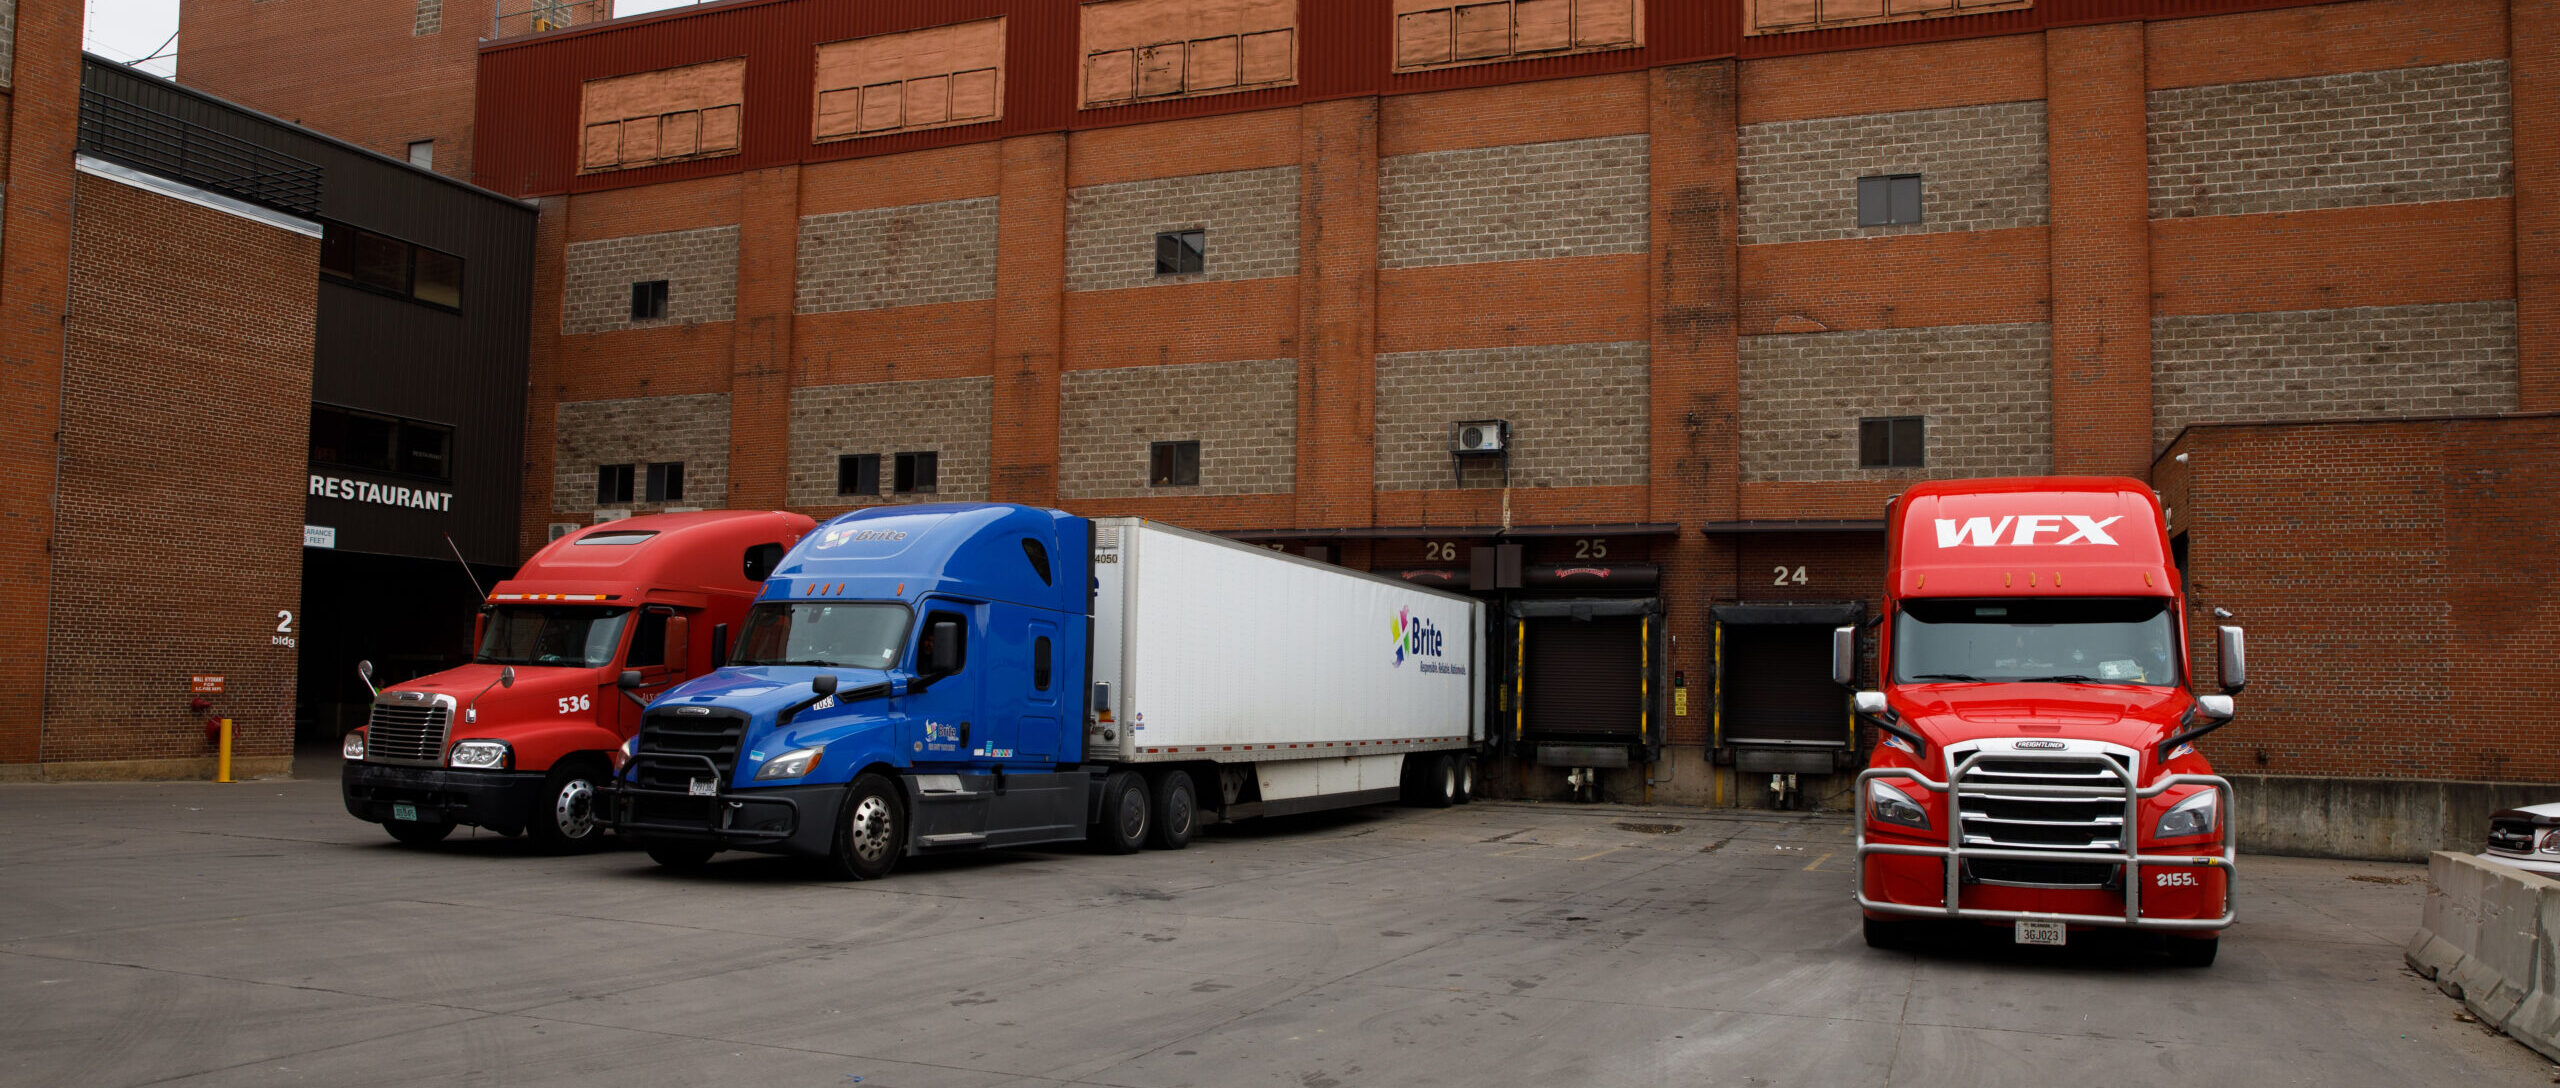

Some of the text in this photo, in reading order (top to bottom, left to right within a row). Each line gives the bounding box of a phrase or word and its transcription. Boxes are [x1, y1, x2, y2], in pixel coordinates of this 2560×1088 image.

[309, 475, 453, 512] RESTAURANT
[310, 536, 325, 544] FEET
[855, 529, 907, 542] Brite
[1934, 514, 2125, 548] WFX
[1425, 541, 1456, 561] 26
[1575, 538, 1607, 558] 25
[1095, 554, 1118, 563] 4050
[1773, 566, 1808, 585] 24
[277, 610, 293, 633] 2
[272, 635, 295, 648] bldg
[1412, 616, 1442, 657] Brite
[558, 694, 590, 714] 536
[938, 724, 957, 737] Brite
[2017, 741, 2064, 749] FREIGHTLINER
